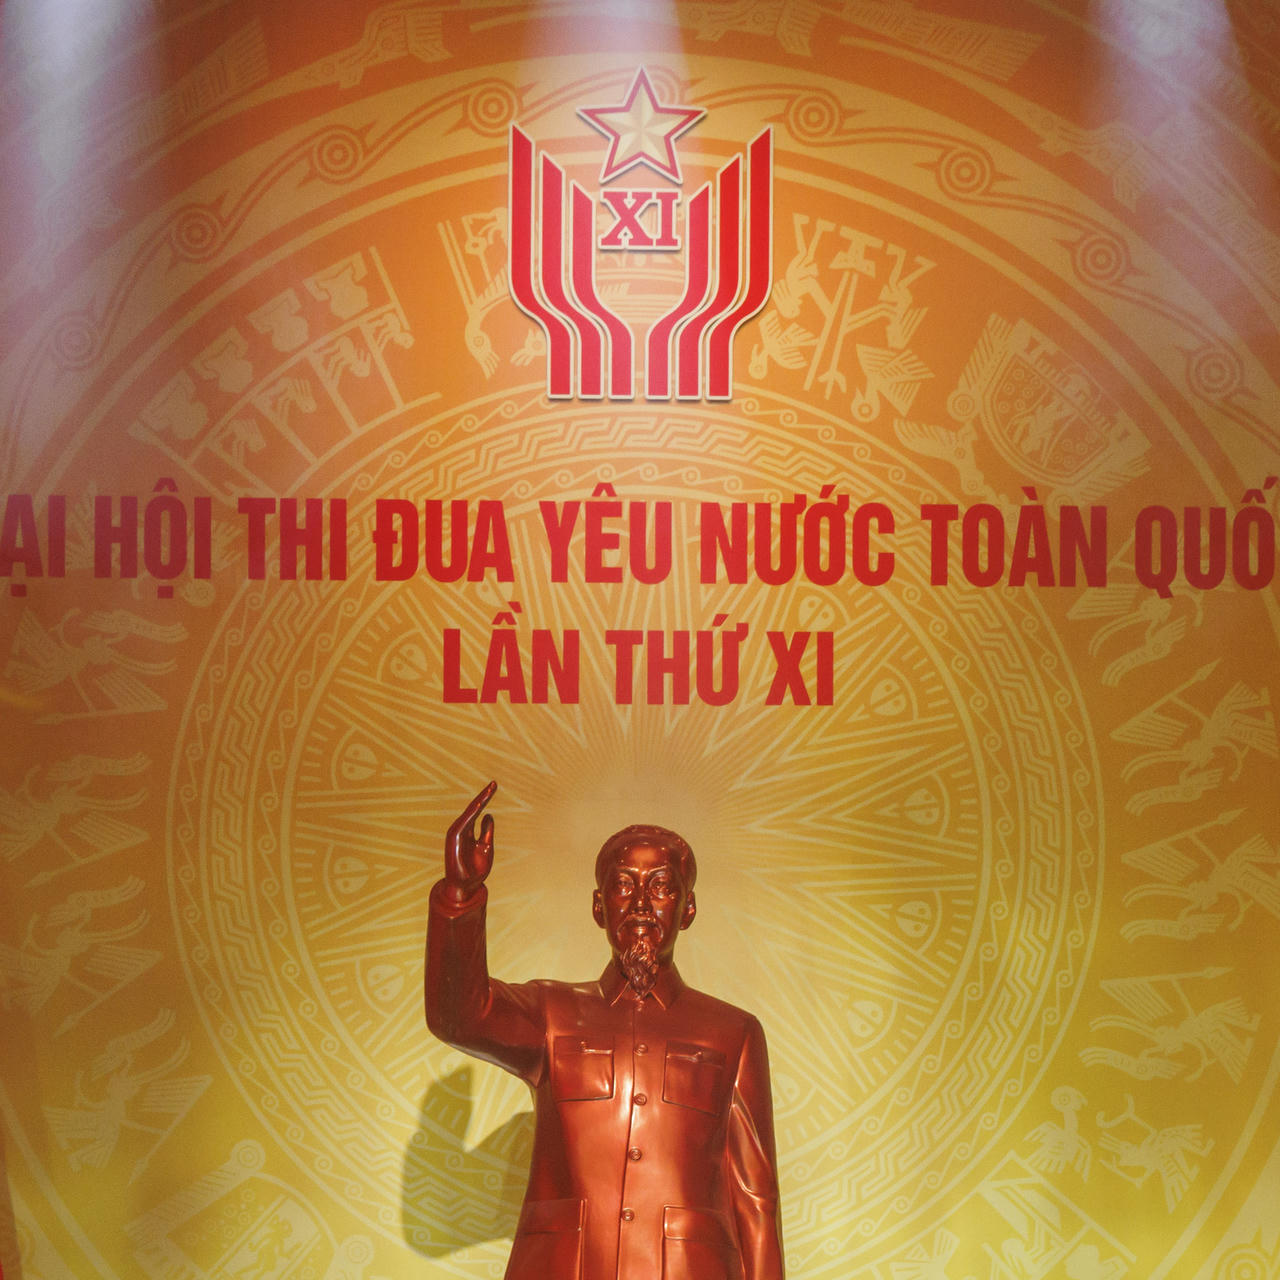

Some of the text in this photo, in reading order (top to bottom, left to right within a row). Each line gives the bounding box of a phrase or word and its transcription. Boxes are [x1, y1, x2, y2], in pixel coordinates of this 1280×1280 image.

[599, 189, 681, 249] XI
[93, 477, 213, 599] HỘI
[237, 497, 348, 582] THI
[372, 498, 515, 583] ĐUA
[538, 482, 672, 585] YÊU
[699, 484, 896, 588] NƯỚC
[920, 486, 1108, 589] TOÀN
[441, 601, 835, 706] LẦN THỨ XI
